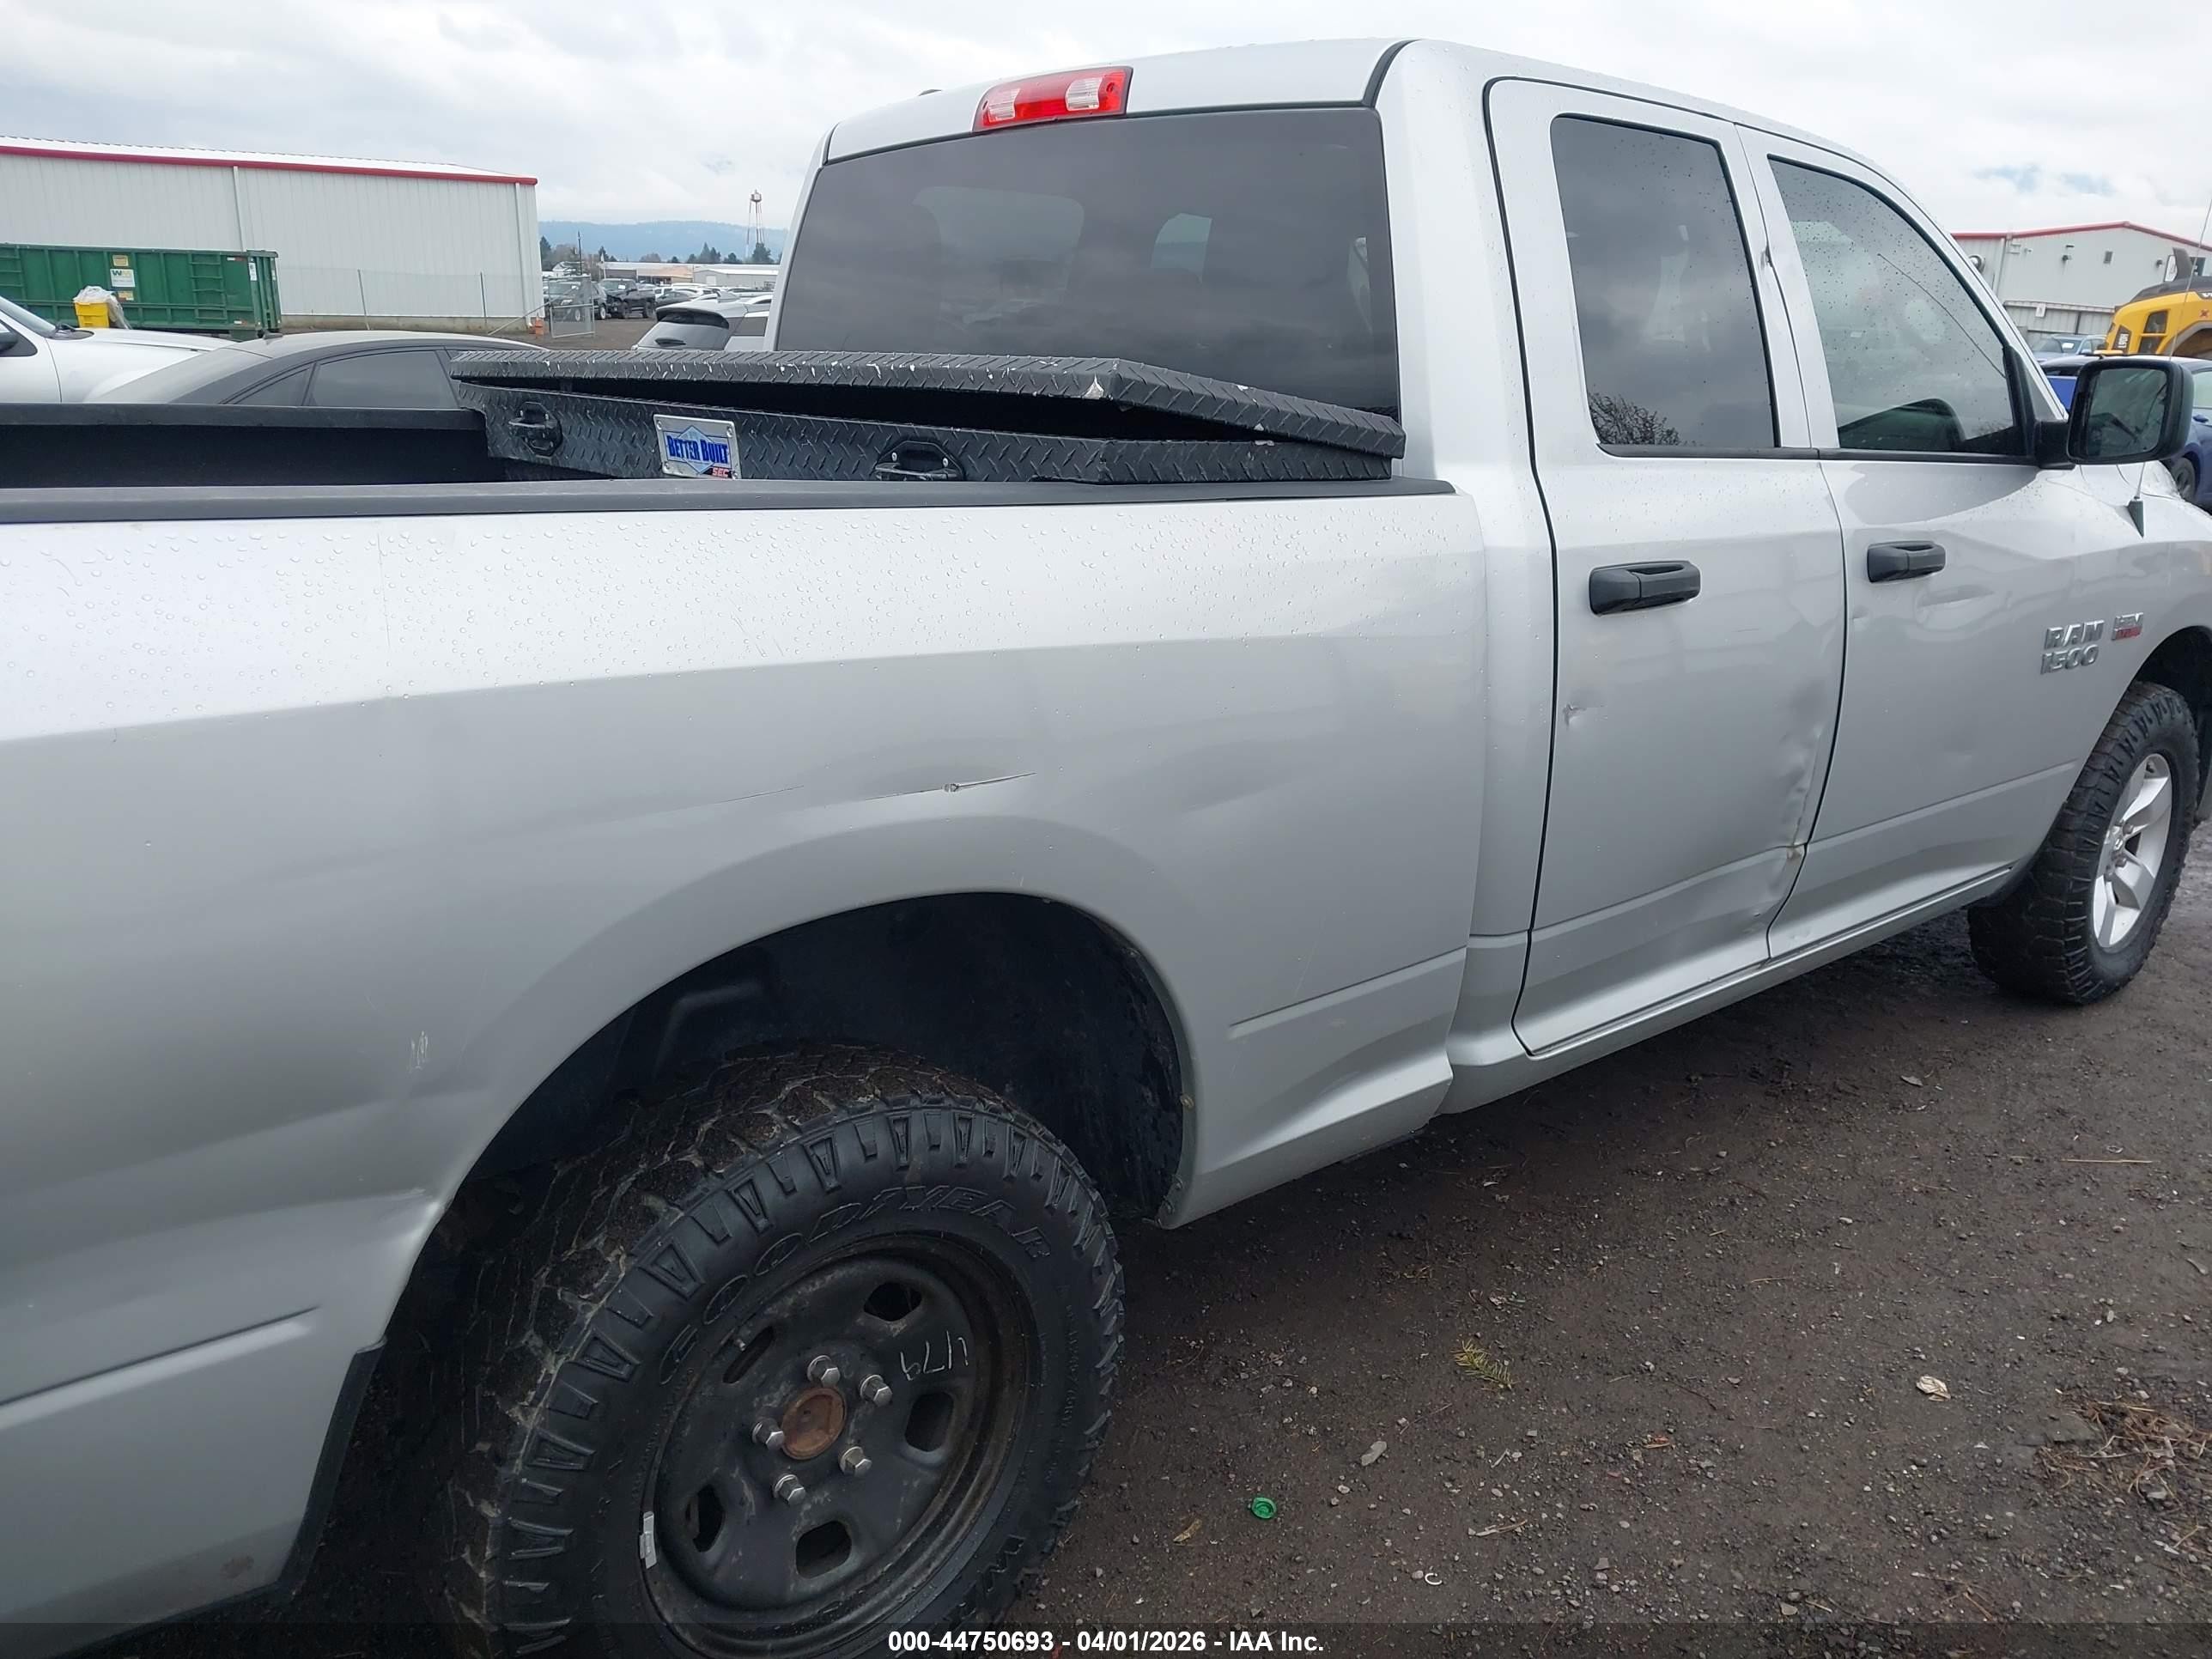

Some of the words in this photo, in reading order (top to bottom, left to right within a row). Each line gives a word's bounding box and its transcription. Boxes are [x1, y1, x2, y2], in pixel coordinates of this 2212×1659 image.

[666, 435, 700, 460] BETTER
[700, 440, 728, 464] BUILT
[2045, 619, 2105, 649] RAM
[2040, 645, 2100, 675] 1500
[659, 1184, 1050, 1385] GOODYEAR
